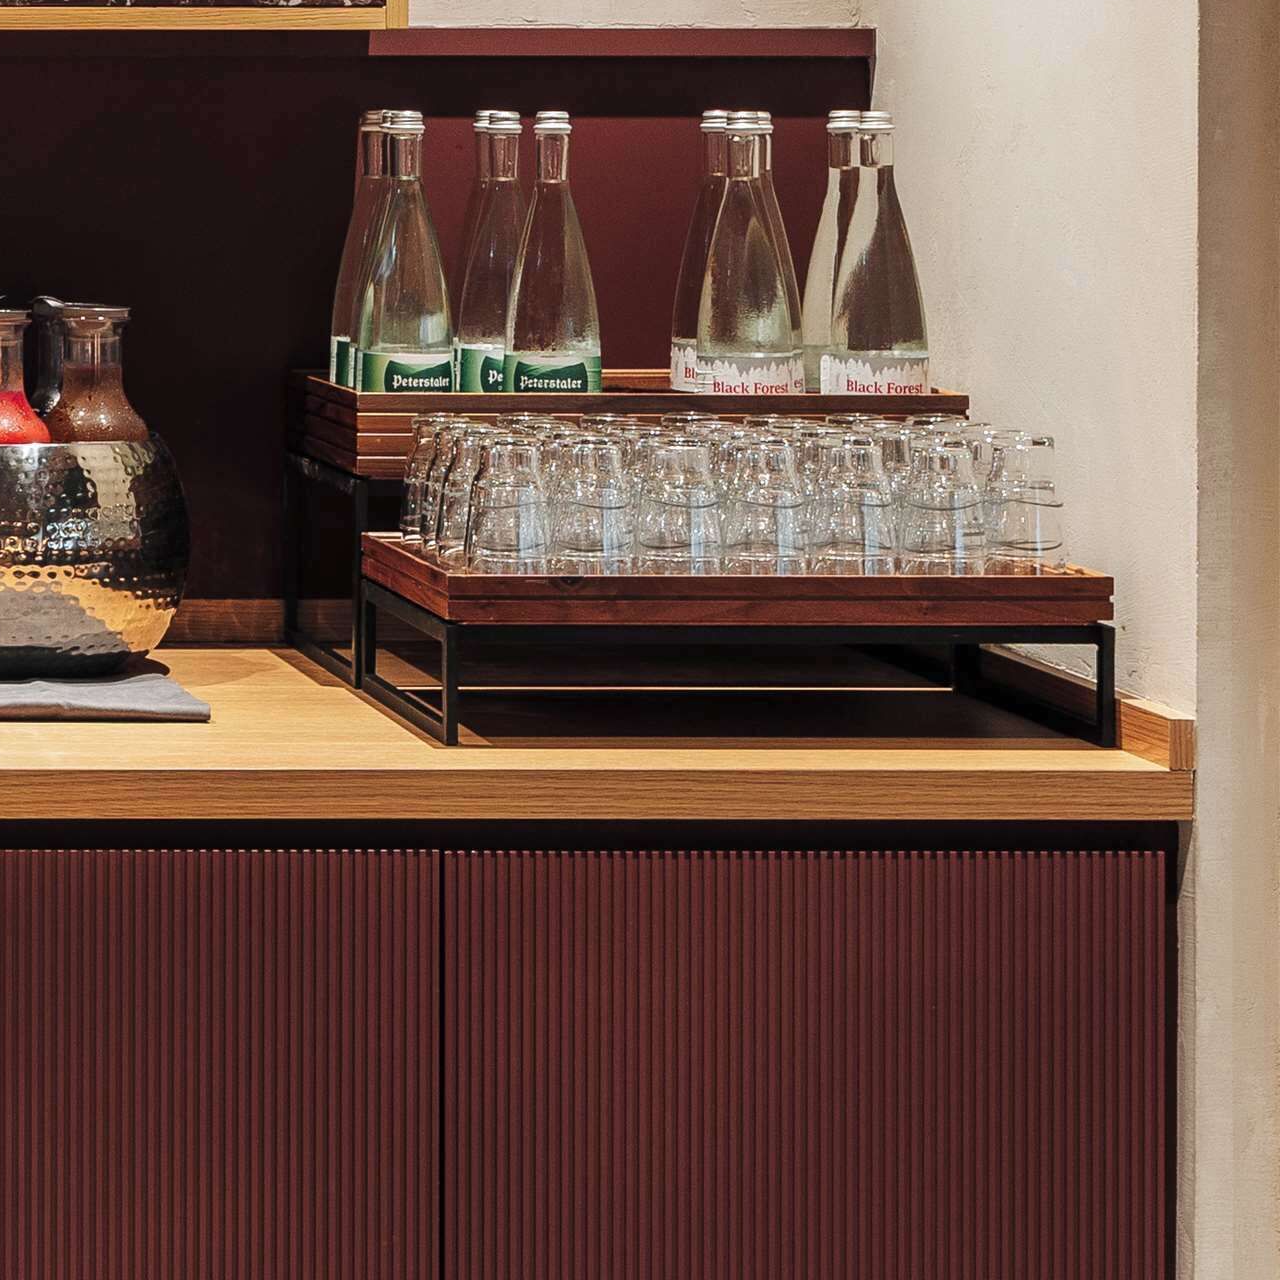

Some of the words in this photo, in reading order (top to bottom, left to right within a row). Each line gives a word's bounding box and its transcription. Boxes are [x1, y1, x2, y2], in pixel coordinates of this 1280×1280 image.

[392, 375, 450, 389] Peterstaler
[519, 375, 582, 389] Peterstaler
[713, 380, 749, 393] Black
[754, 381, 788, 393] Forest
[846, 379, 882, 393] Black
[887, 381, 923, 393] Forest
